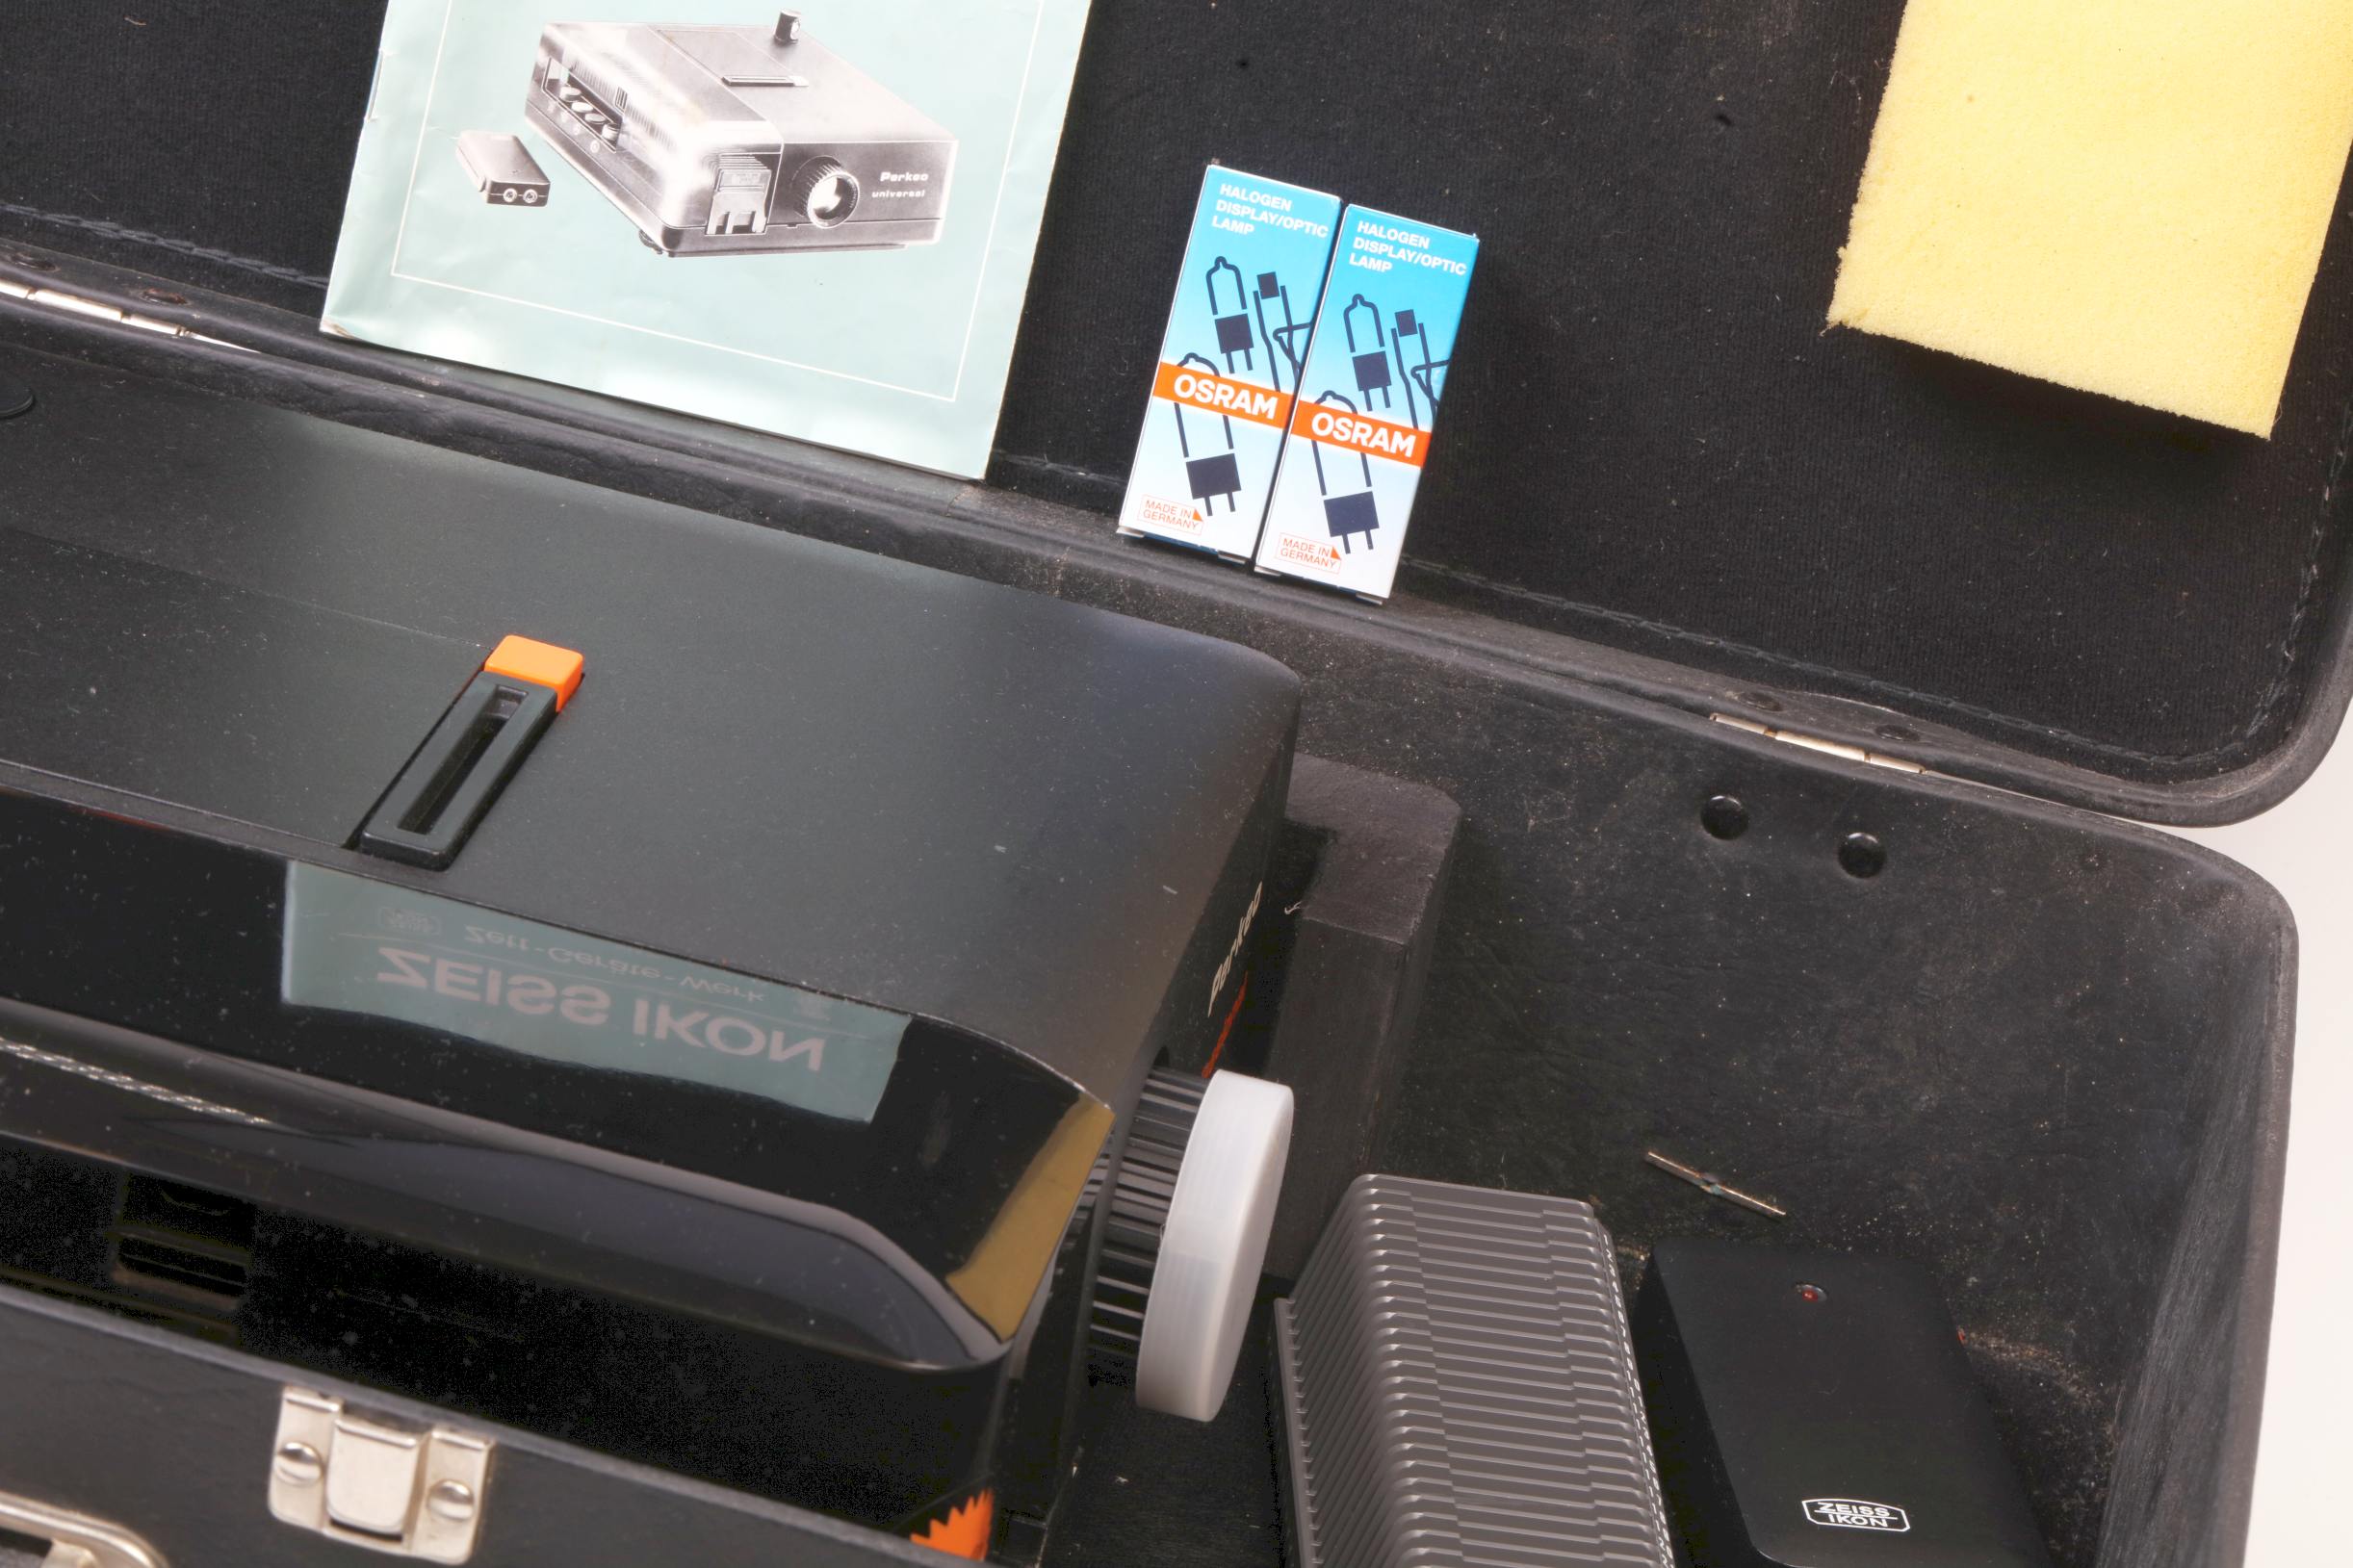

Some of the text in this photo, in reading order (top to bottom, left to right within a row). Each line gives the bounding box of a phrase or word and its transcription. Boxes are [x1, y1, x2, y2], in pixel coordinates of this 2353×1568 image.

[1219, 183, 1293, 212] HALOGEN
[1211, 215, 1255, 236] LAMP
[1215, 199, 1329, 238] DISPLAY/OPTIC
[1357, 219, 1431, 249] HALOGEN
[1349, 252, 1393, 273] LAMP
[1353, 236, 1467, 276] DISPLAY/OPTIC
[1173, 373, 1280, 420] OSRAM
[1310, 412, 1417, 458] OSRAM
[1142, 508, 1200, 530] GERMANY
[1145, 500, 1193, 520] MADE IN
[1280, 547, 1337, 569] GERMANY
[1282, 537, 1331, 558] MADE IN
[1817, 1502, 1890, 1518] ZEISS
[1827, 1512, 1889, 1529] IKON
